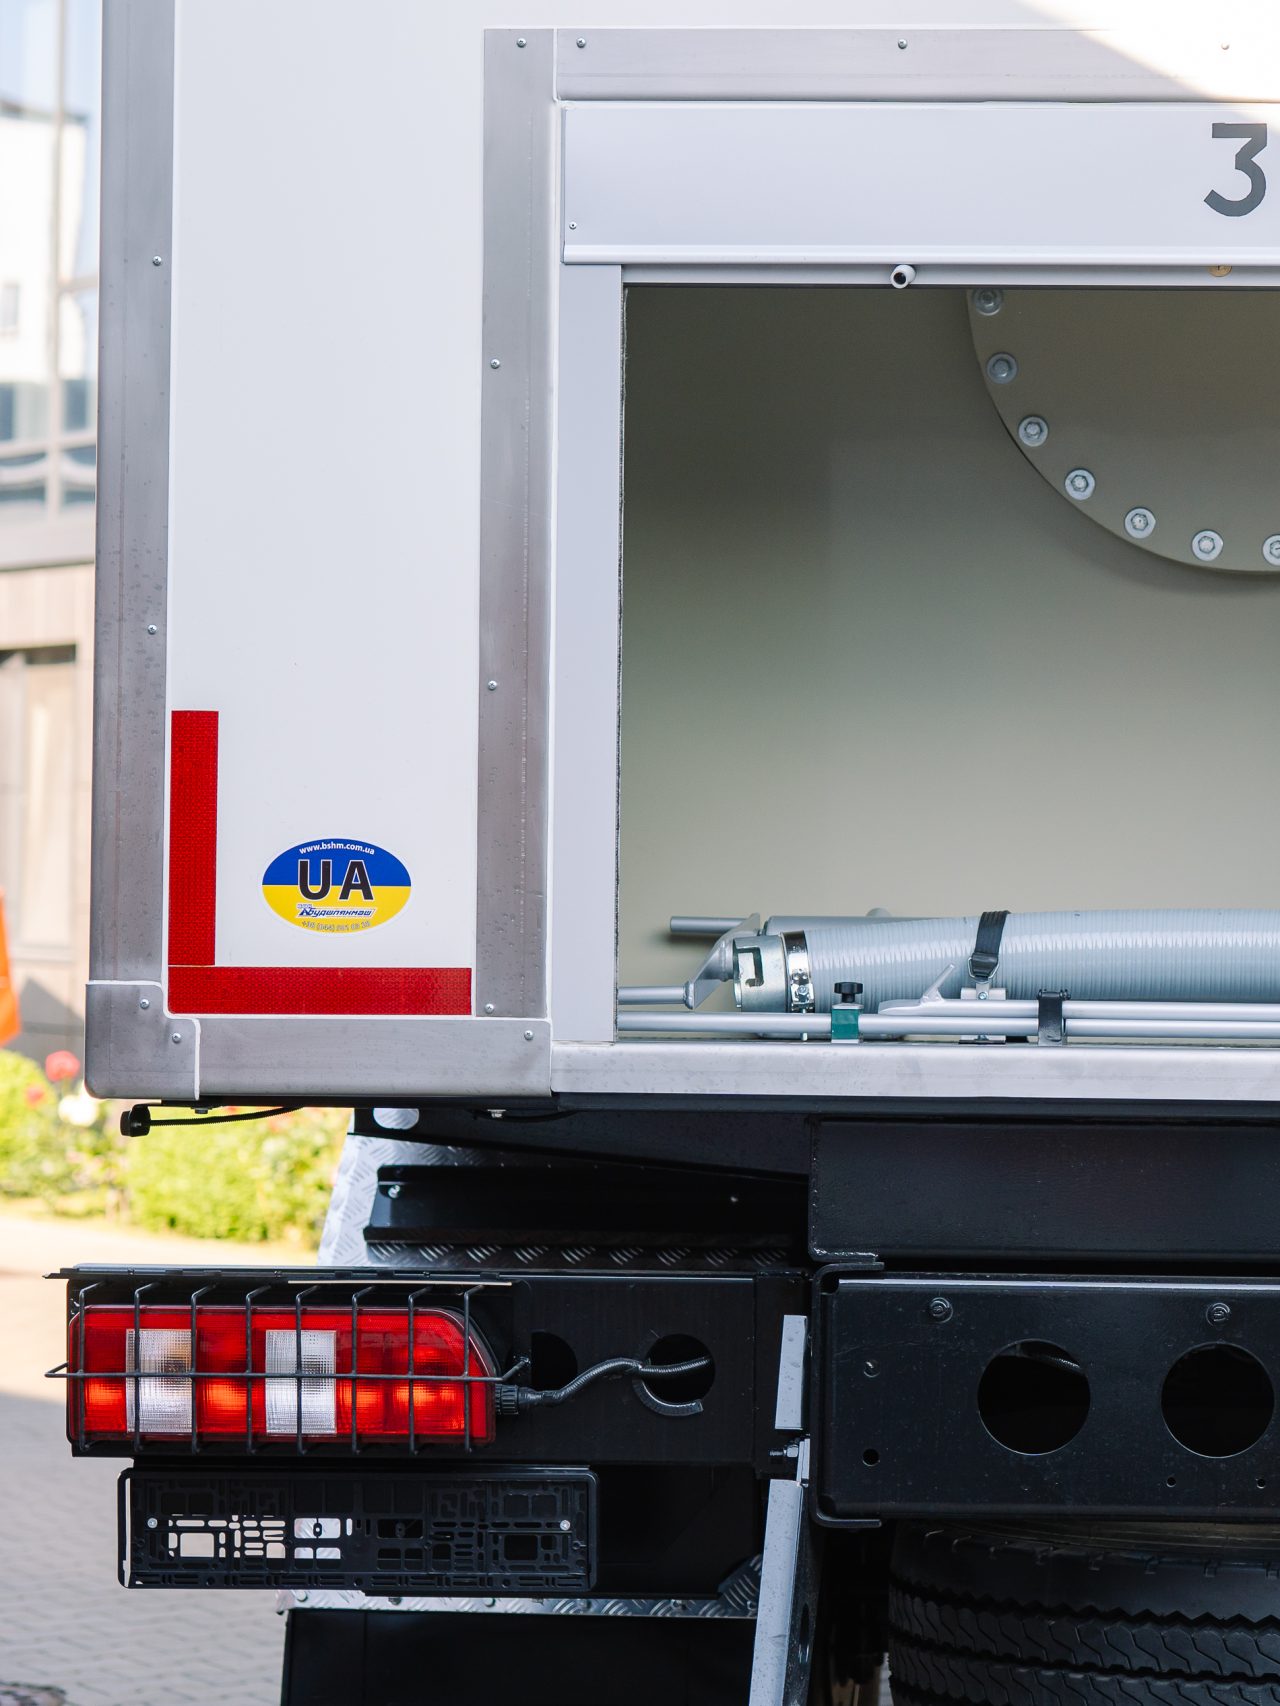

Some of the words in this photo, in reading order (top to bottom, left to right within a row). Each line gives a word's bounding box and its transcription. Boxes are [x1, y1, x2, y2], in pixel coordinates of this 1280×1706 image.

[1204, 123, 1267, 217] 3
[299, 841, 375, 855] www.bshm.com.ua
[298, 859, 374, 901] UA
